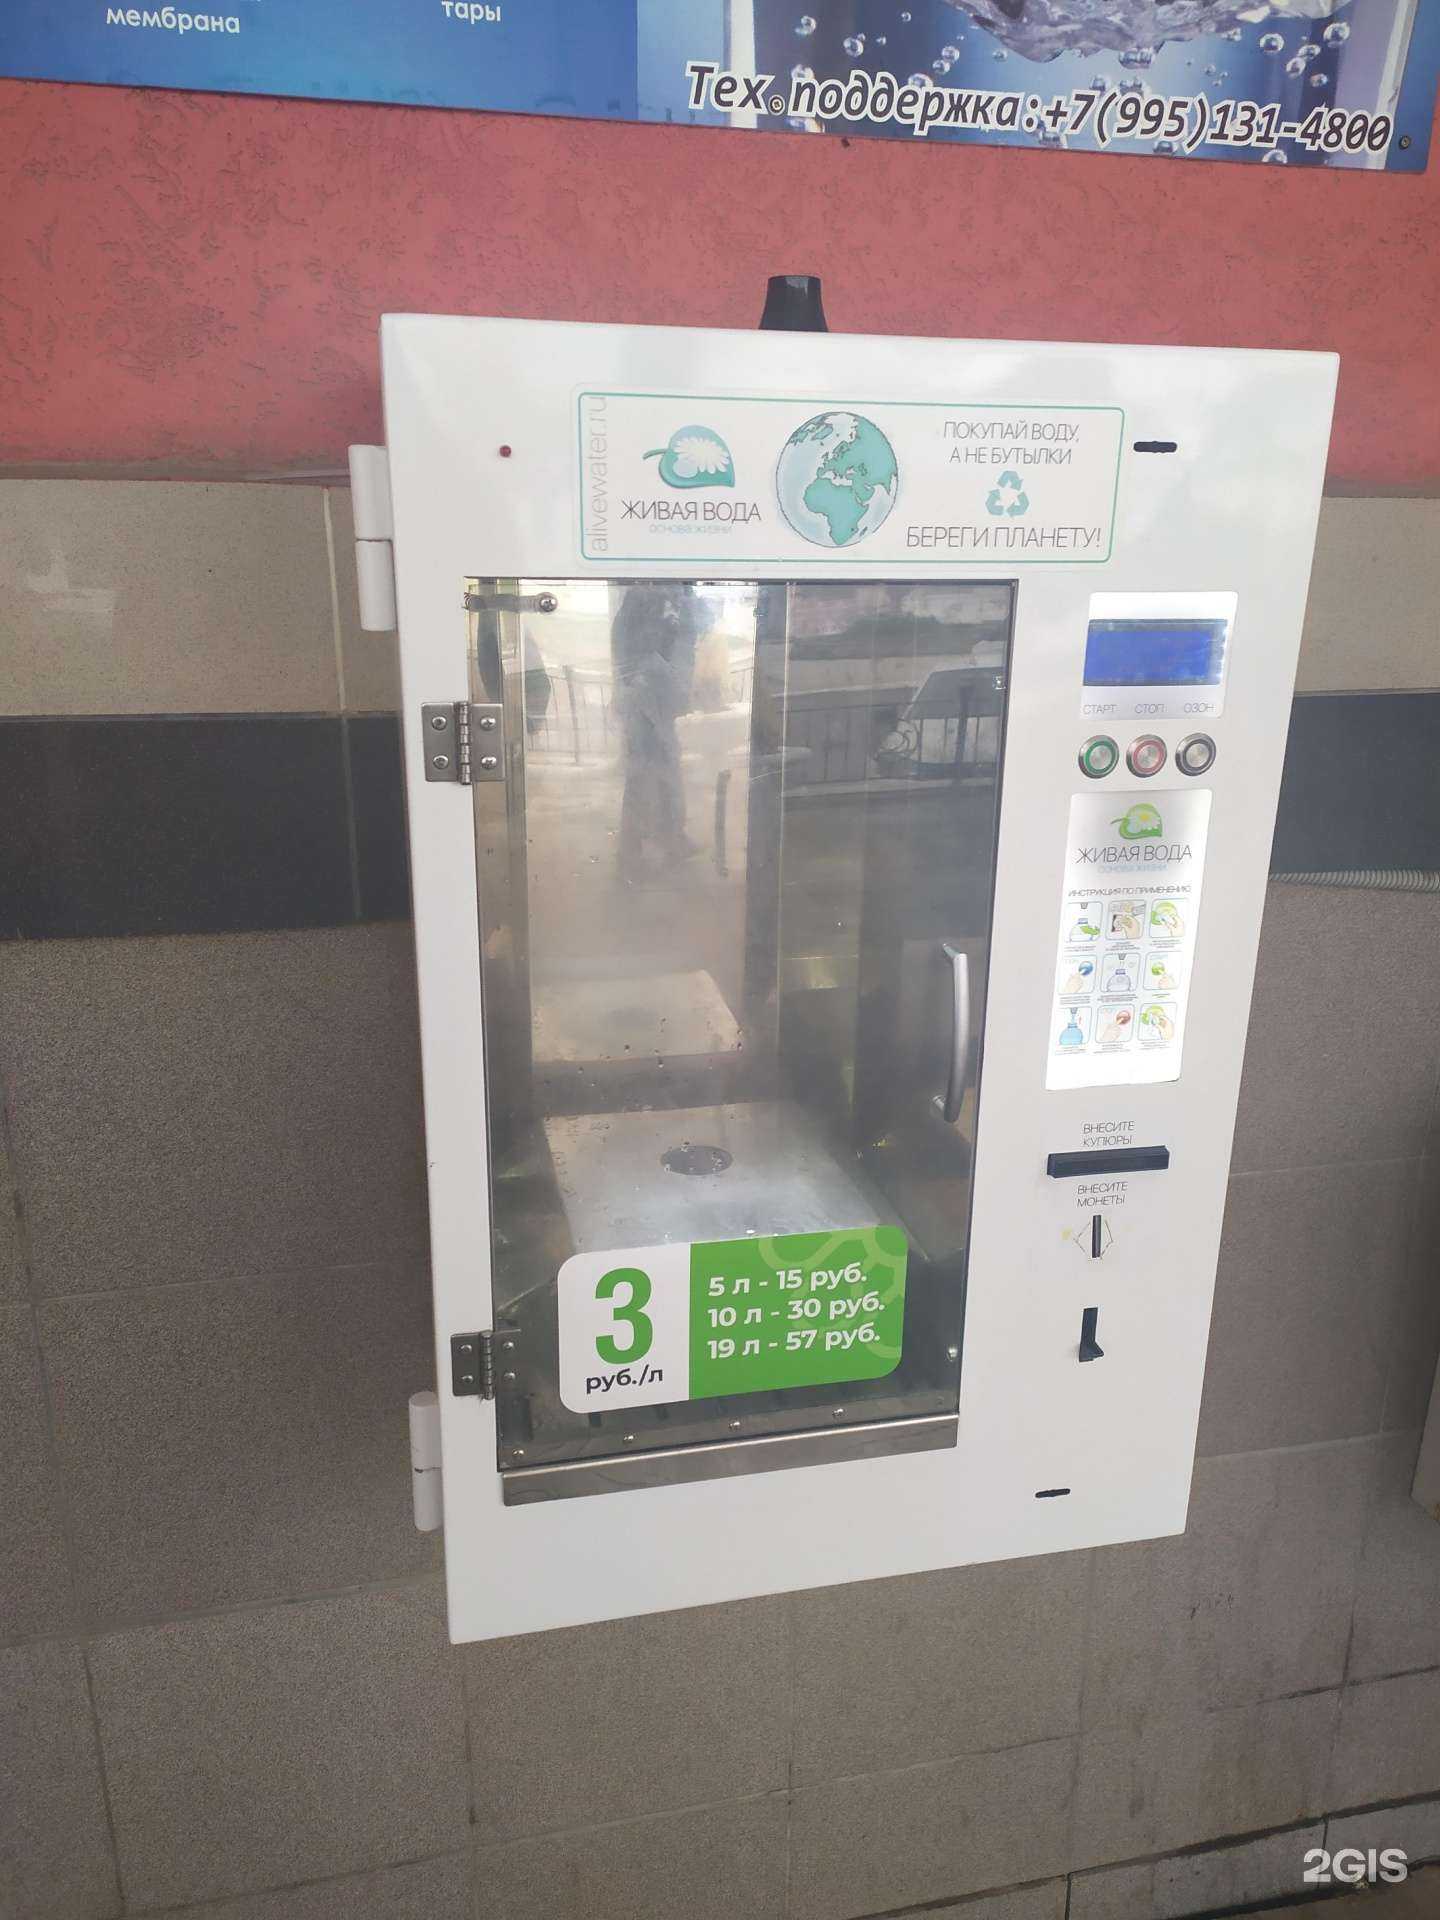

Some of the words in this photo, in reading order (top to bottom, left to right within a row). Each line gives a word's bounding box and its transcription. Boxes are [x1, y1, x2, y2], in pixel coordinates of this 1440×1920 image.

[106, 6, 241, 35] мембрана
[441, 0, 502, 25] тары
[943, 420, 1028, 441] ПОКУПАЙ
[1031, 423, 1080, 443] ВОДУ,
[949, 447, 961, 463] А
[965, 448, 987, 464] НЕ
[991, 448, 1072, 465] БУТЫЛКИ
[620, 500, 698, 521] ЖИВАЯ
[702, 501, 762, 524] ВОДА
[906, 526, 989, 548] БЕРЕГИ
[994, 527, 1102, 549] ПЛАНЕТУ!
[1082, 704, 1116, 715] СТАРТ
[1135, 703, 1165, 714] СТОП
[1183, 702, 1214, 714] ОЗОН
[1076, 845, 1140, 864] ЖИВАЯ
[1143, 844, 1192, 863] ВОДА
[1083, 1121, 1135, 1134] ВНЕСИТЕ
[1083, 1135, 1132, 1147] КУПЮРЫ
[1077, 1181, 1128, 1195] ВНЕСИТЕ
[1076, 1195, 1125, 1207] МОНЕТЫ
[708, 1276, 726, 1297] 5
[731, 1276, 750, 1296] л
[776, 1269, 802, 1290] 15
[810, 1262, 867, 1291] руб.
[594, 1267, 653, 1365] 3
[707, 1307, 737, 1328] 10
[743, 1307, 762, 1325] л
[787, 1299, 822, 1320] 30
[828, 1291, 885, 1320] руб.
[707, 1339, 736, 1360] 19
[742, 1338, 760, 1357] л
[785, 1330, 818, 1351] 57
[824, 1322, 881, 1351] руб.
[585, 1364, 663, 1394] руб./л
